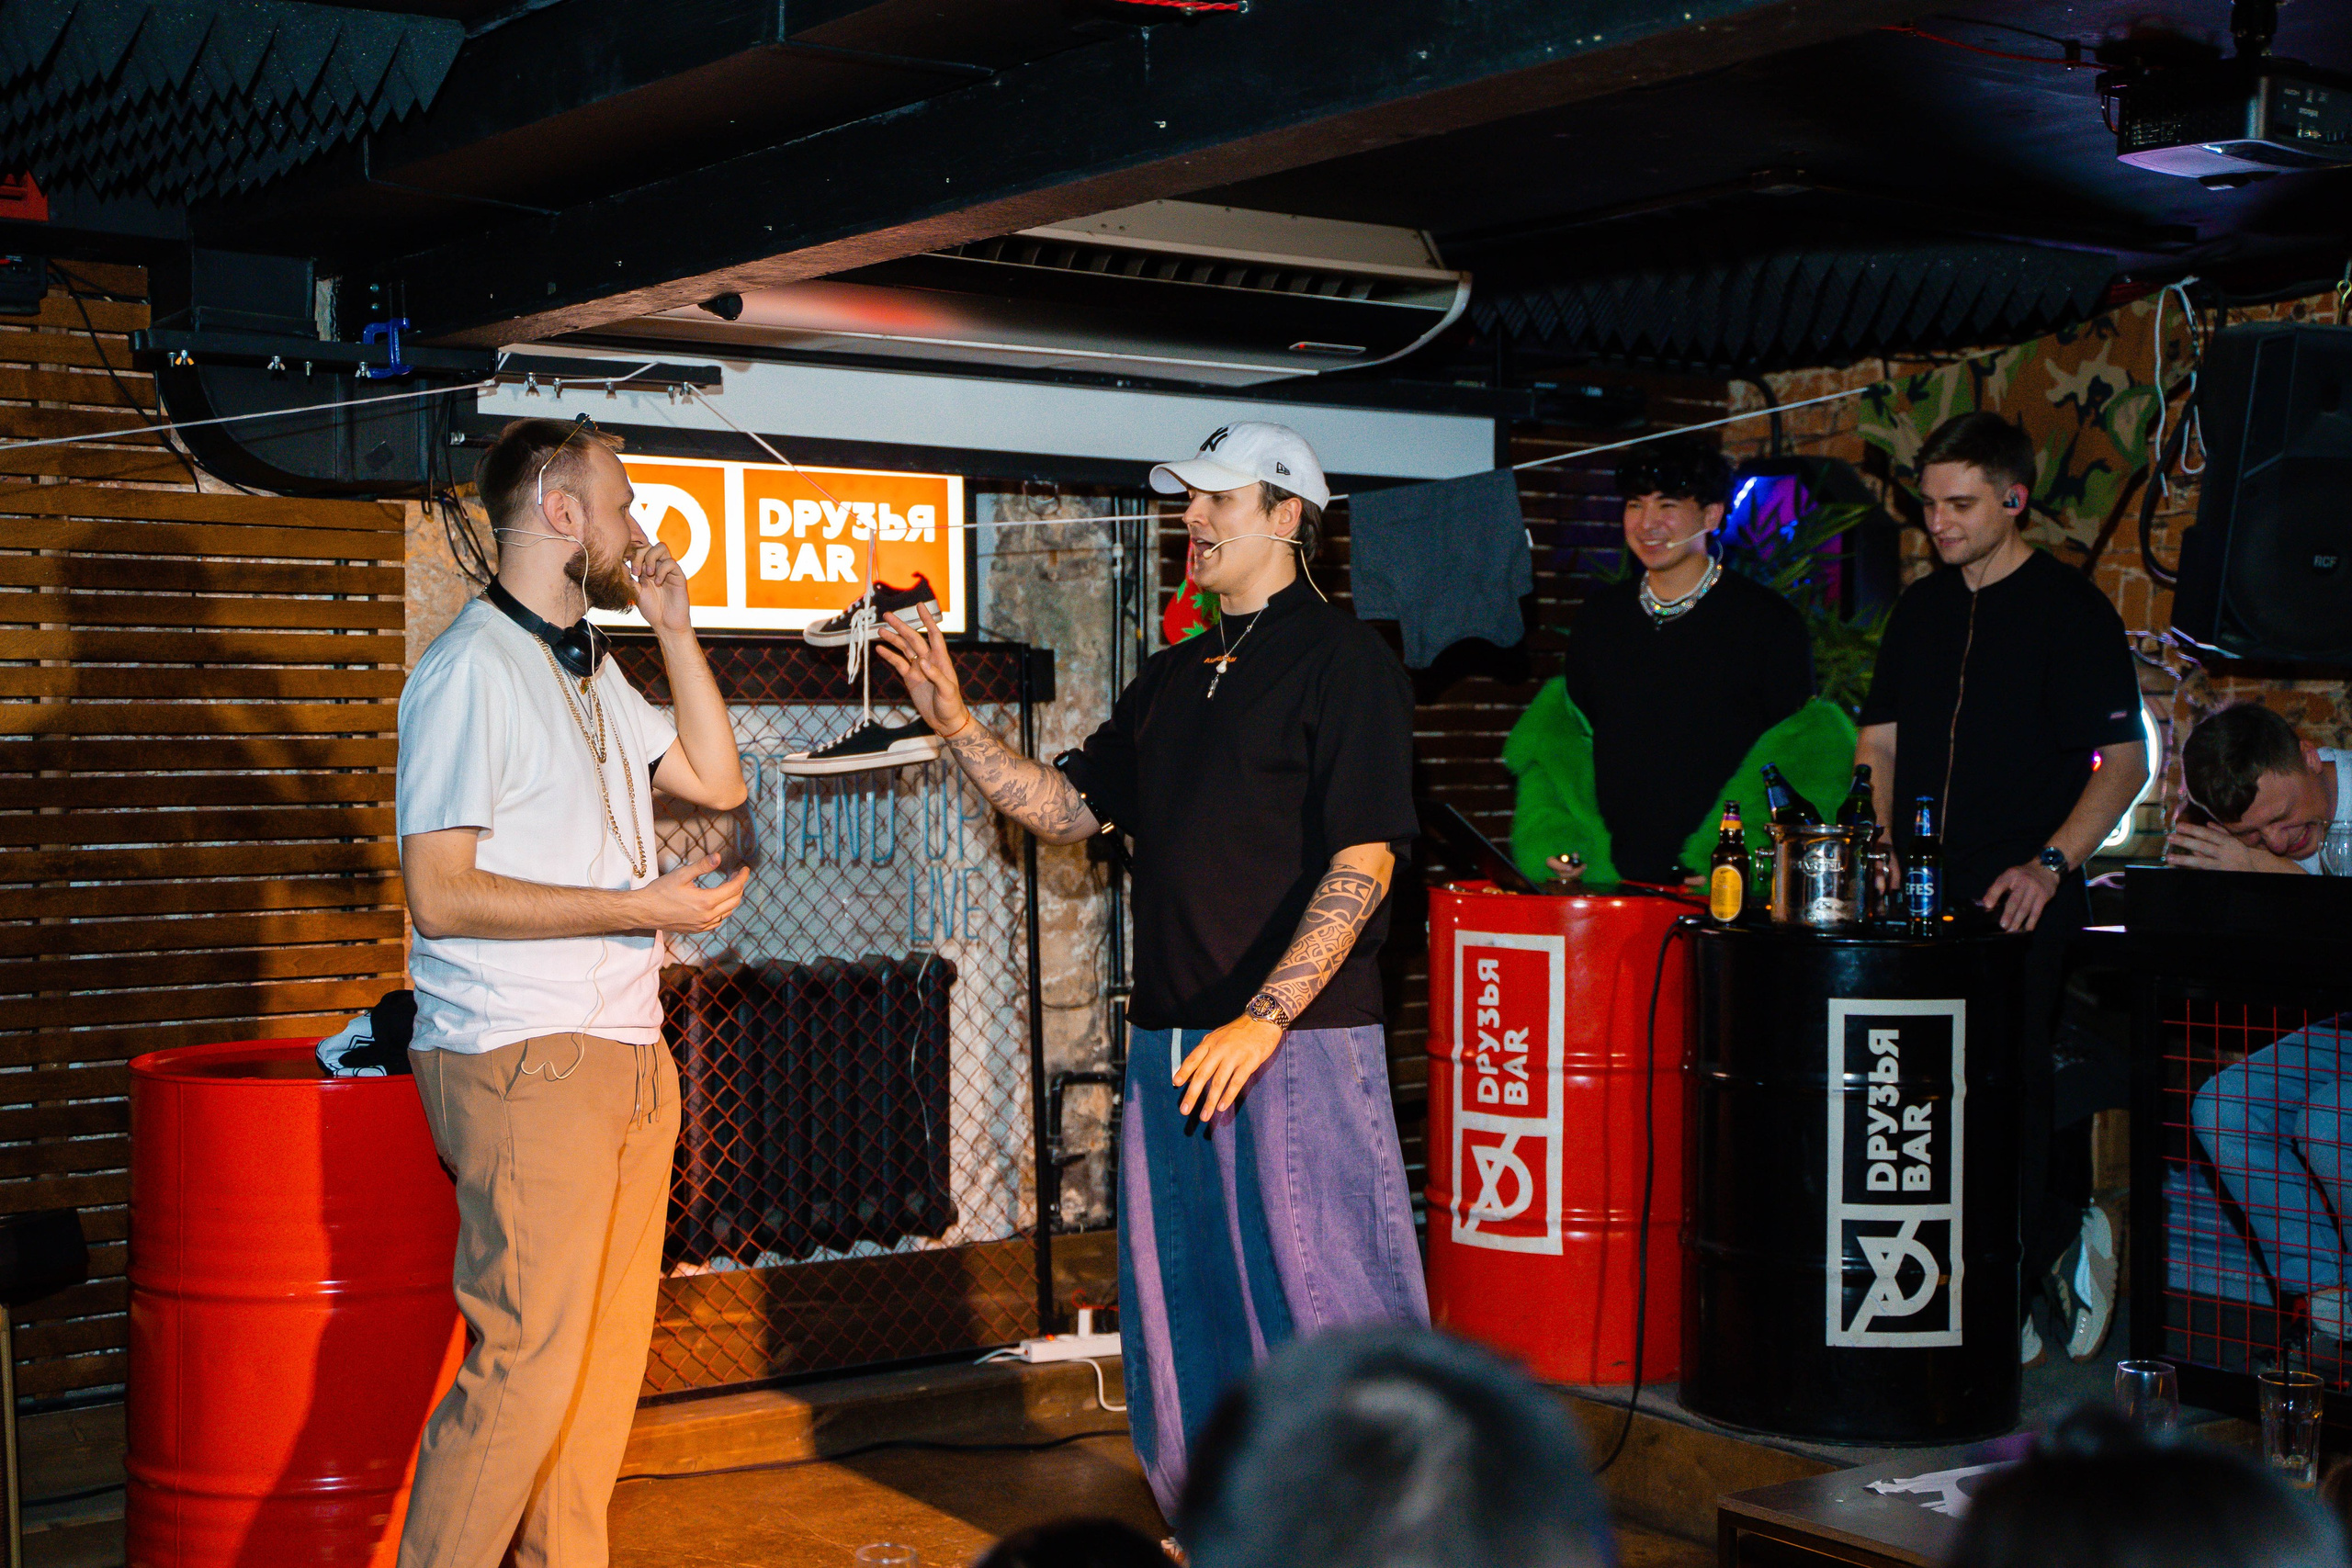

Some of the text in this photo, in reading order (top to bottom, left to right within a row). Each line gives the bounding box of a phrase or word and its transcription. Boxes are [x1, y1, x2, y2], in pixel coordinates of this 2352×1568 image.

[759, 542, 859, 582] BAR
[909, 865, 983, 941] LIVE
[1905, 882, 1935, 897] EFES
[1502, 1026, 1530, 1106] BAR
[1902, 1101, 1932, 1191] BAR
